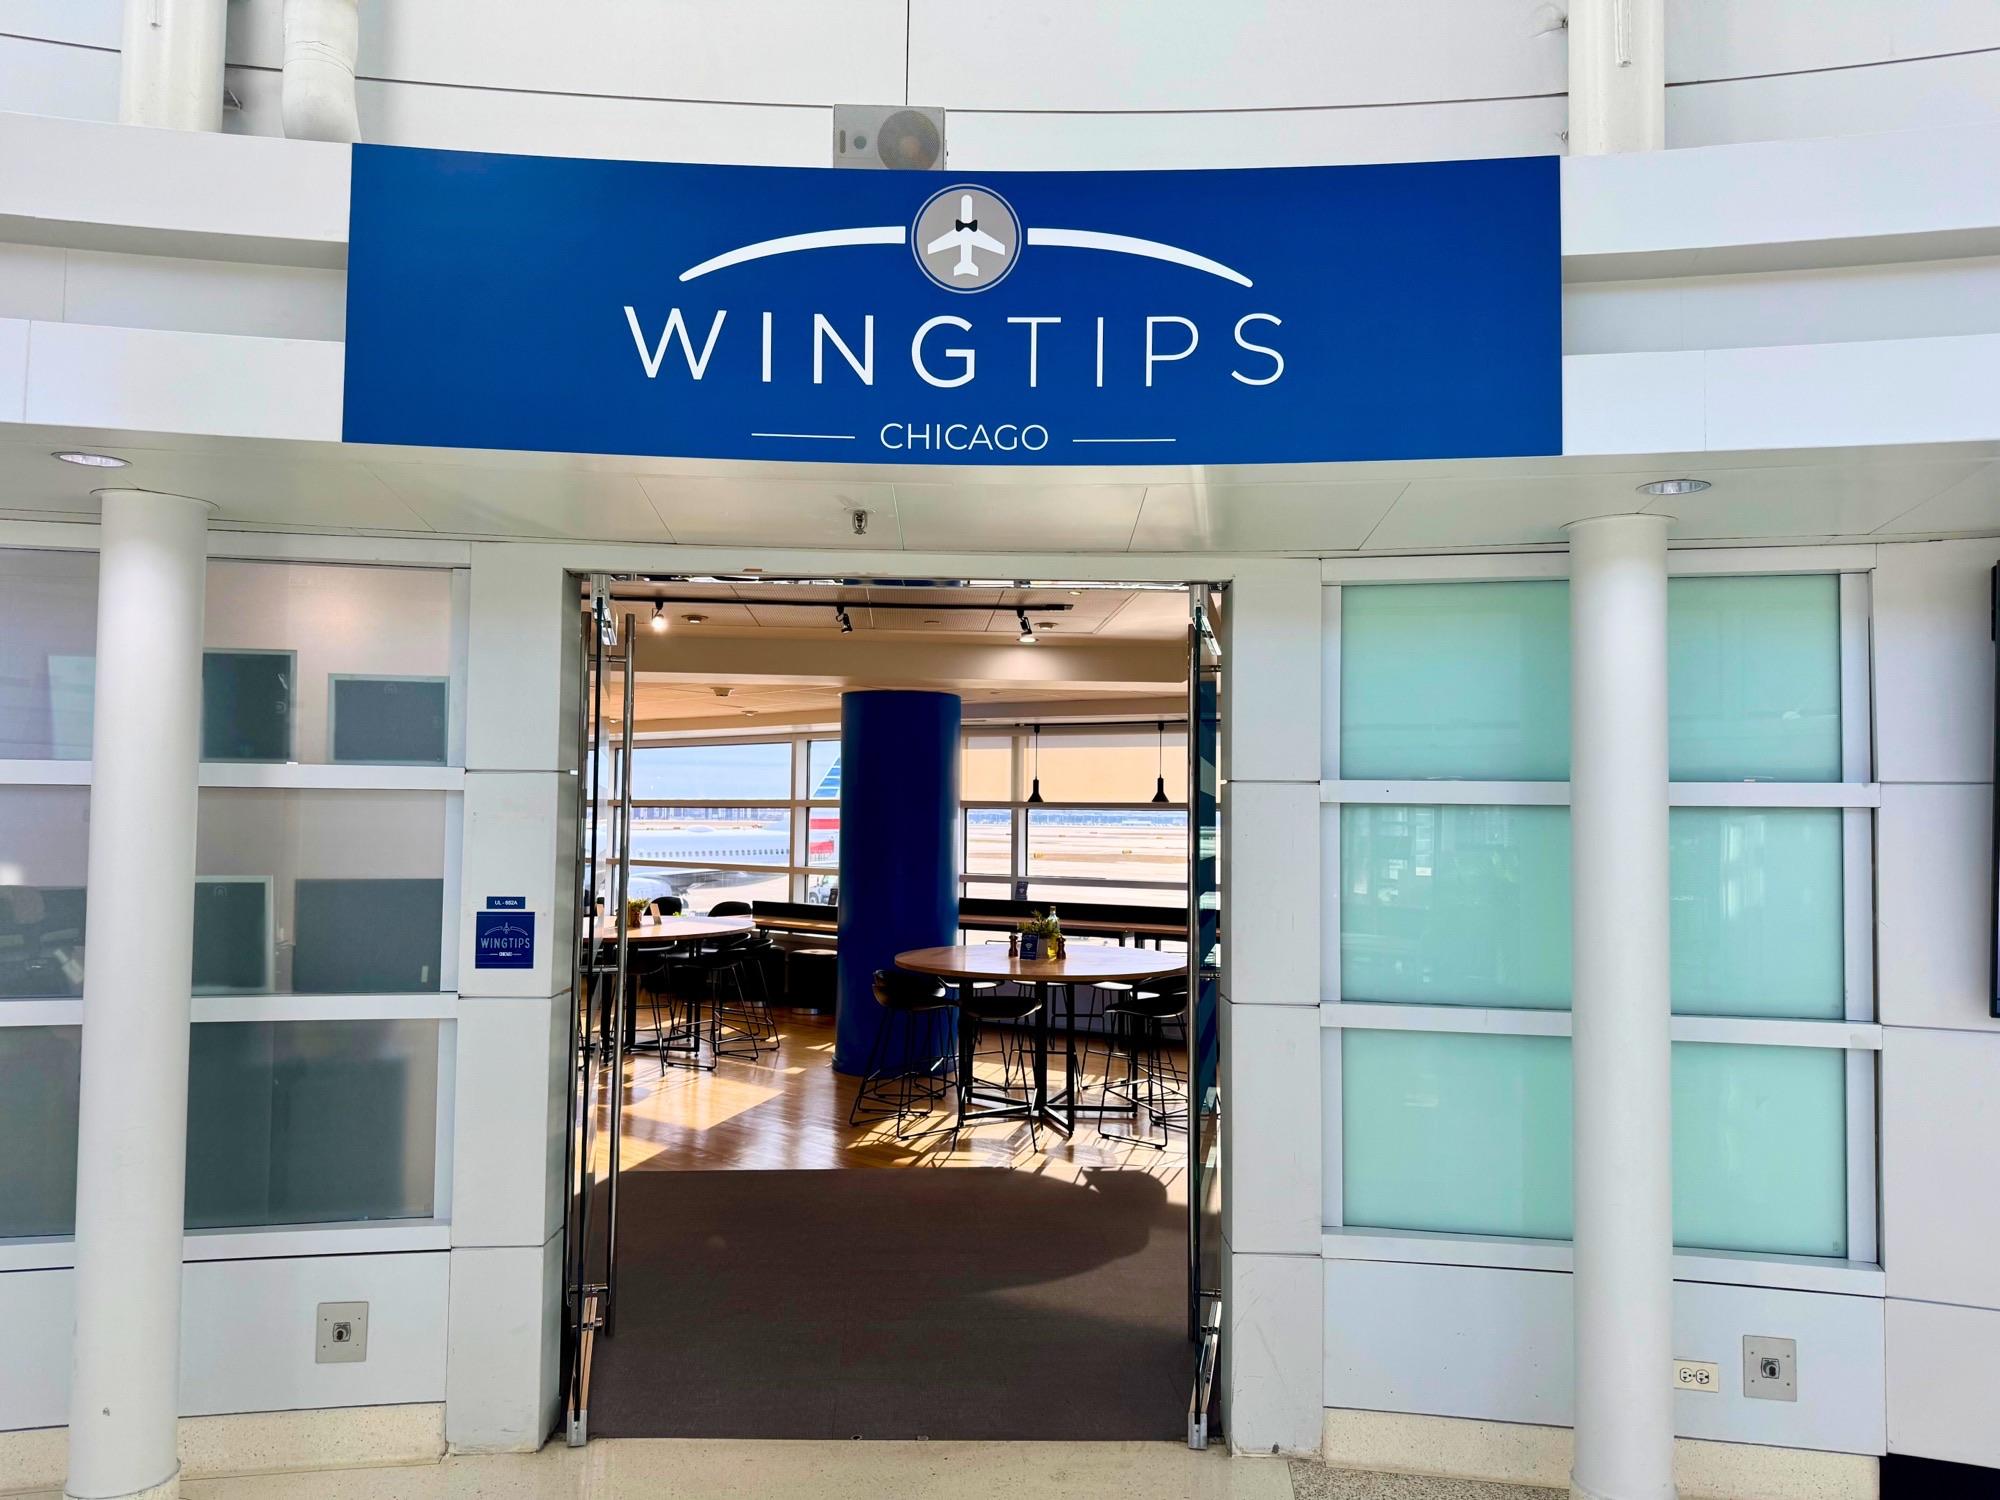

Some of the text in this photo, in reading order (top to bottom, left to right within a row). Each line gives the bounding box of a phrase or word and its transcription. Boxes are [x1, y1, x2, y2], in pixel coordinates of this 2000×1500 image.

[624, 306, 1285, 388] WINGTIPS
[881, 422, 1049, 451] CHICAGO
[480, 937, 530, 949] WINGTIPS
